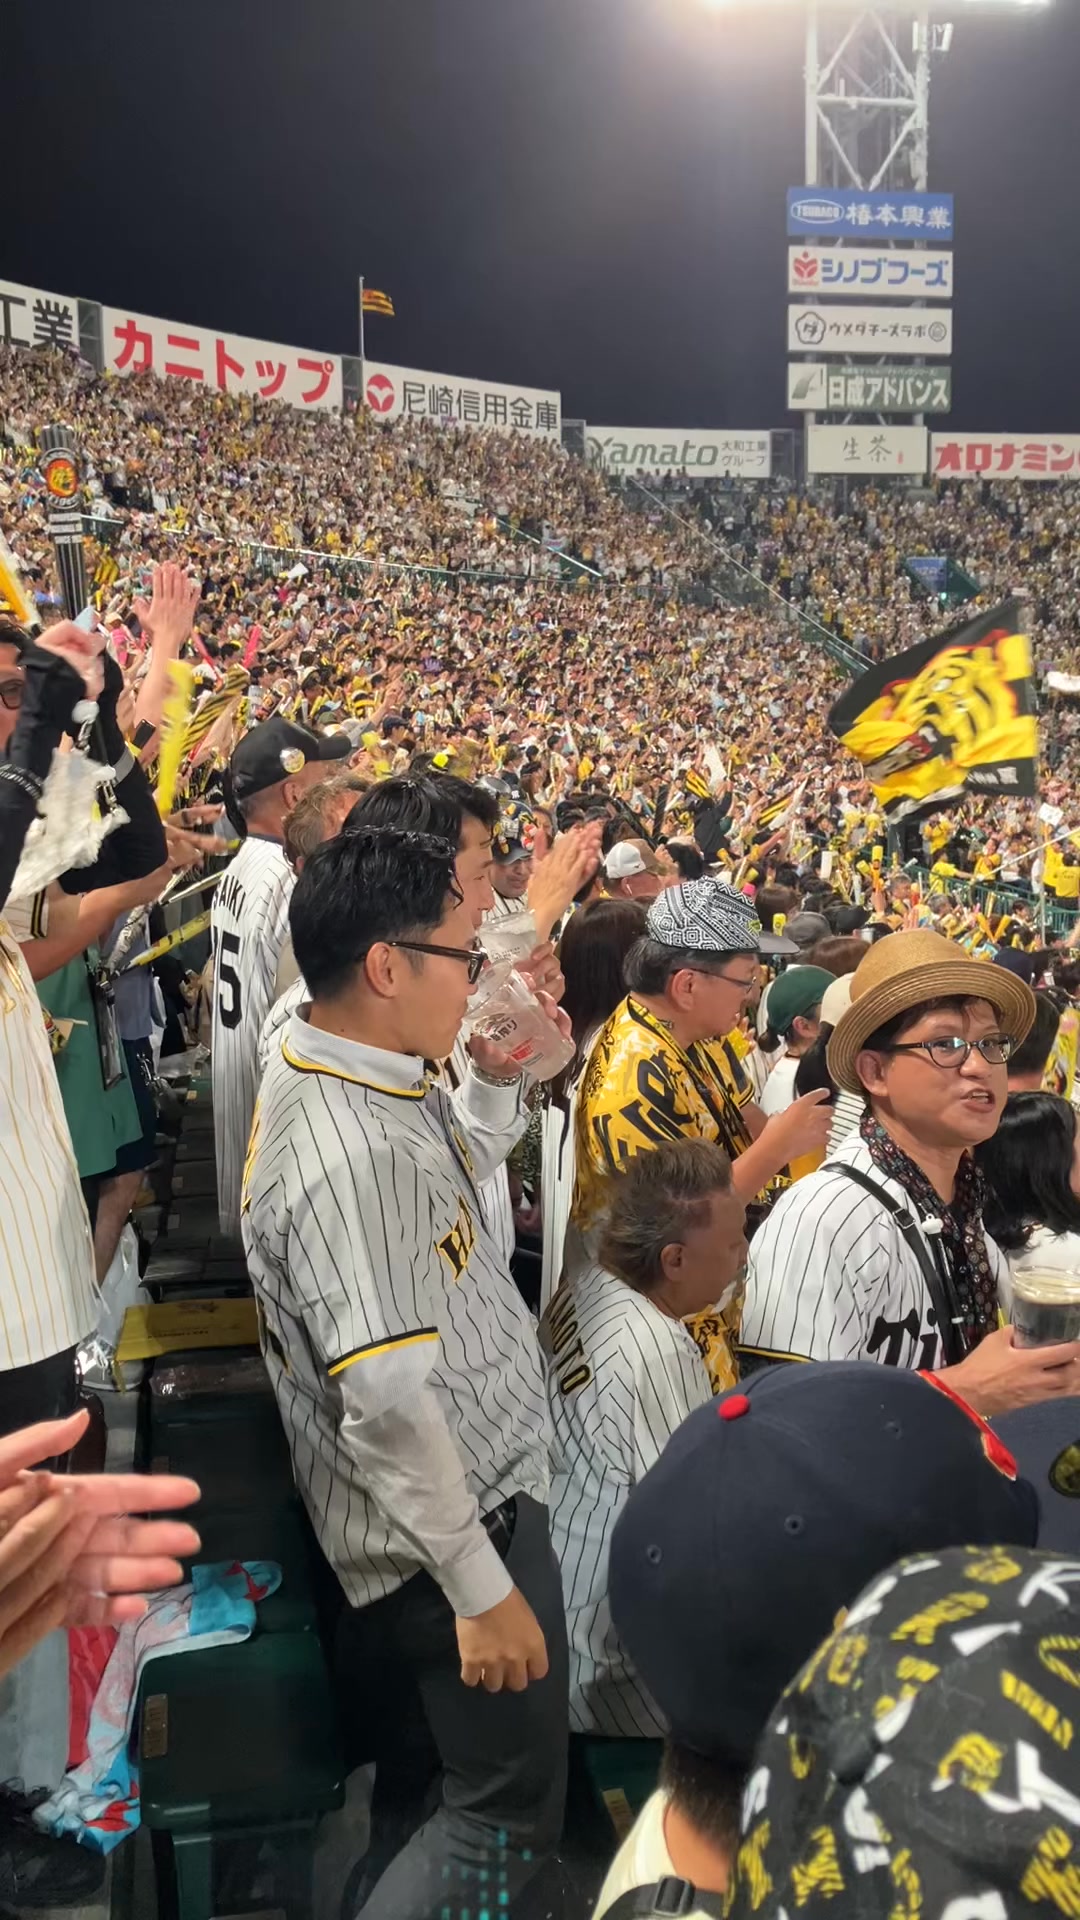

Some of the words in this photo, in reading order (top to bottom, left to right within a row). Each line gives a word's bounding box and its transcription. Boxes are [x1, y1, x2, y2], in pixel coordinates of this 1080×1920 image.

[845, 201, 952, 230] 椿本興業
[821, 257, 950, 287] シノブフーズ
[828, 320, 926, 338] ウメダチーズラボ
[113, 319, 335, 404] カニトップ
[402, 380, 559, 432] 尼崎信用金庫
[828, 374, 949, 407] 日成アドバンス
[586, 436, 719, 467] Yamato
[721, 455, 766, 467] グループ
[842, 433, 893, 464] 生茶
[934, 442, 1080, 472] オロナミン
[211, 924, 243, 1031] 5
